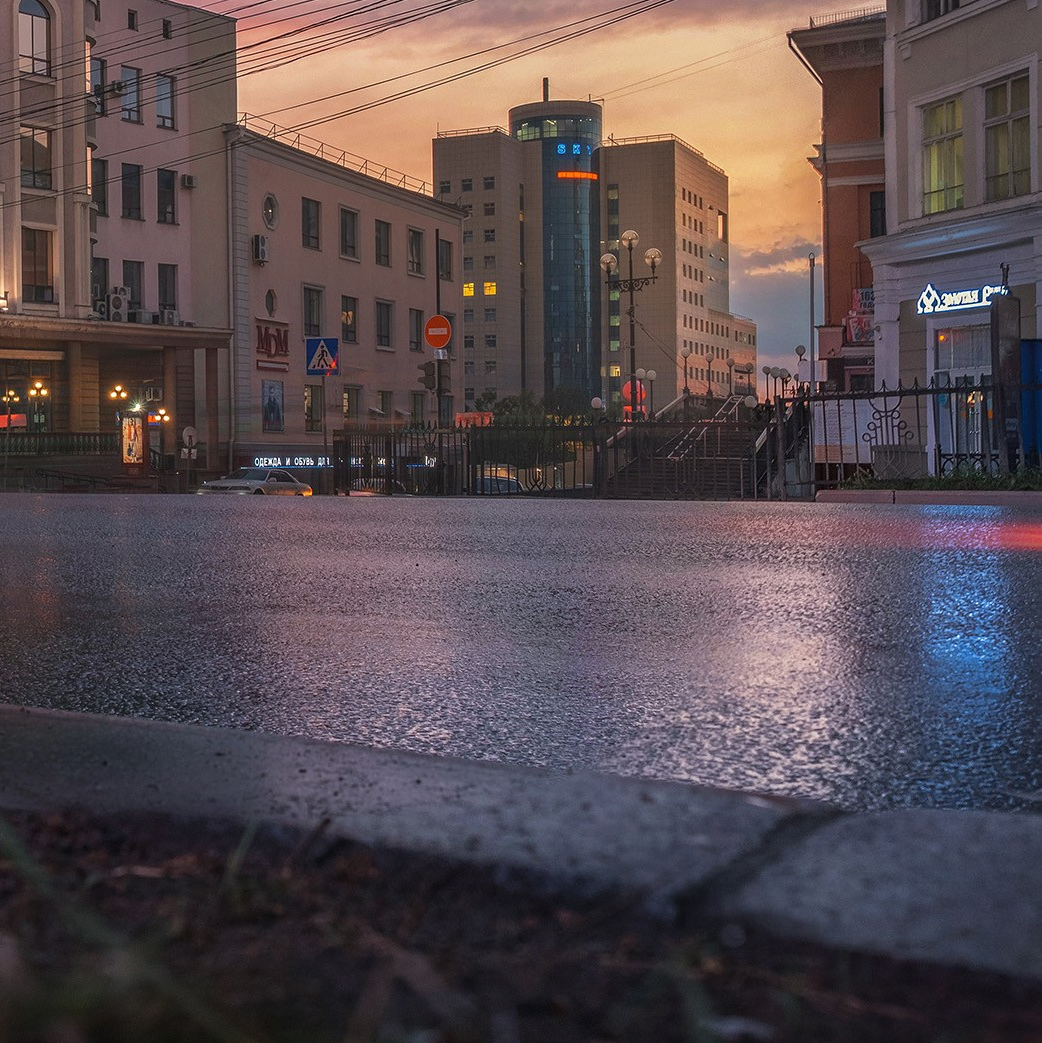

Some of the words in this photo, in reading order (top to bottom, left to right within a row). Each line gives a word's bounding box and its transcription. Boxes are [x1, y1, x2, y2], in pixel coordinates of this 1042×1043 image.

[254, 457, 282, 467] ОДЕЖДА
[285, 457, 291, 466] И
[294, 457, 315, 466] ОБУВЬ
